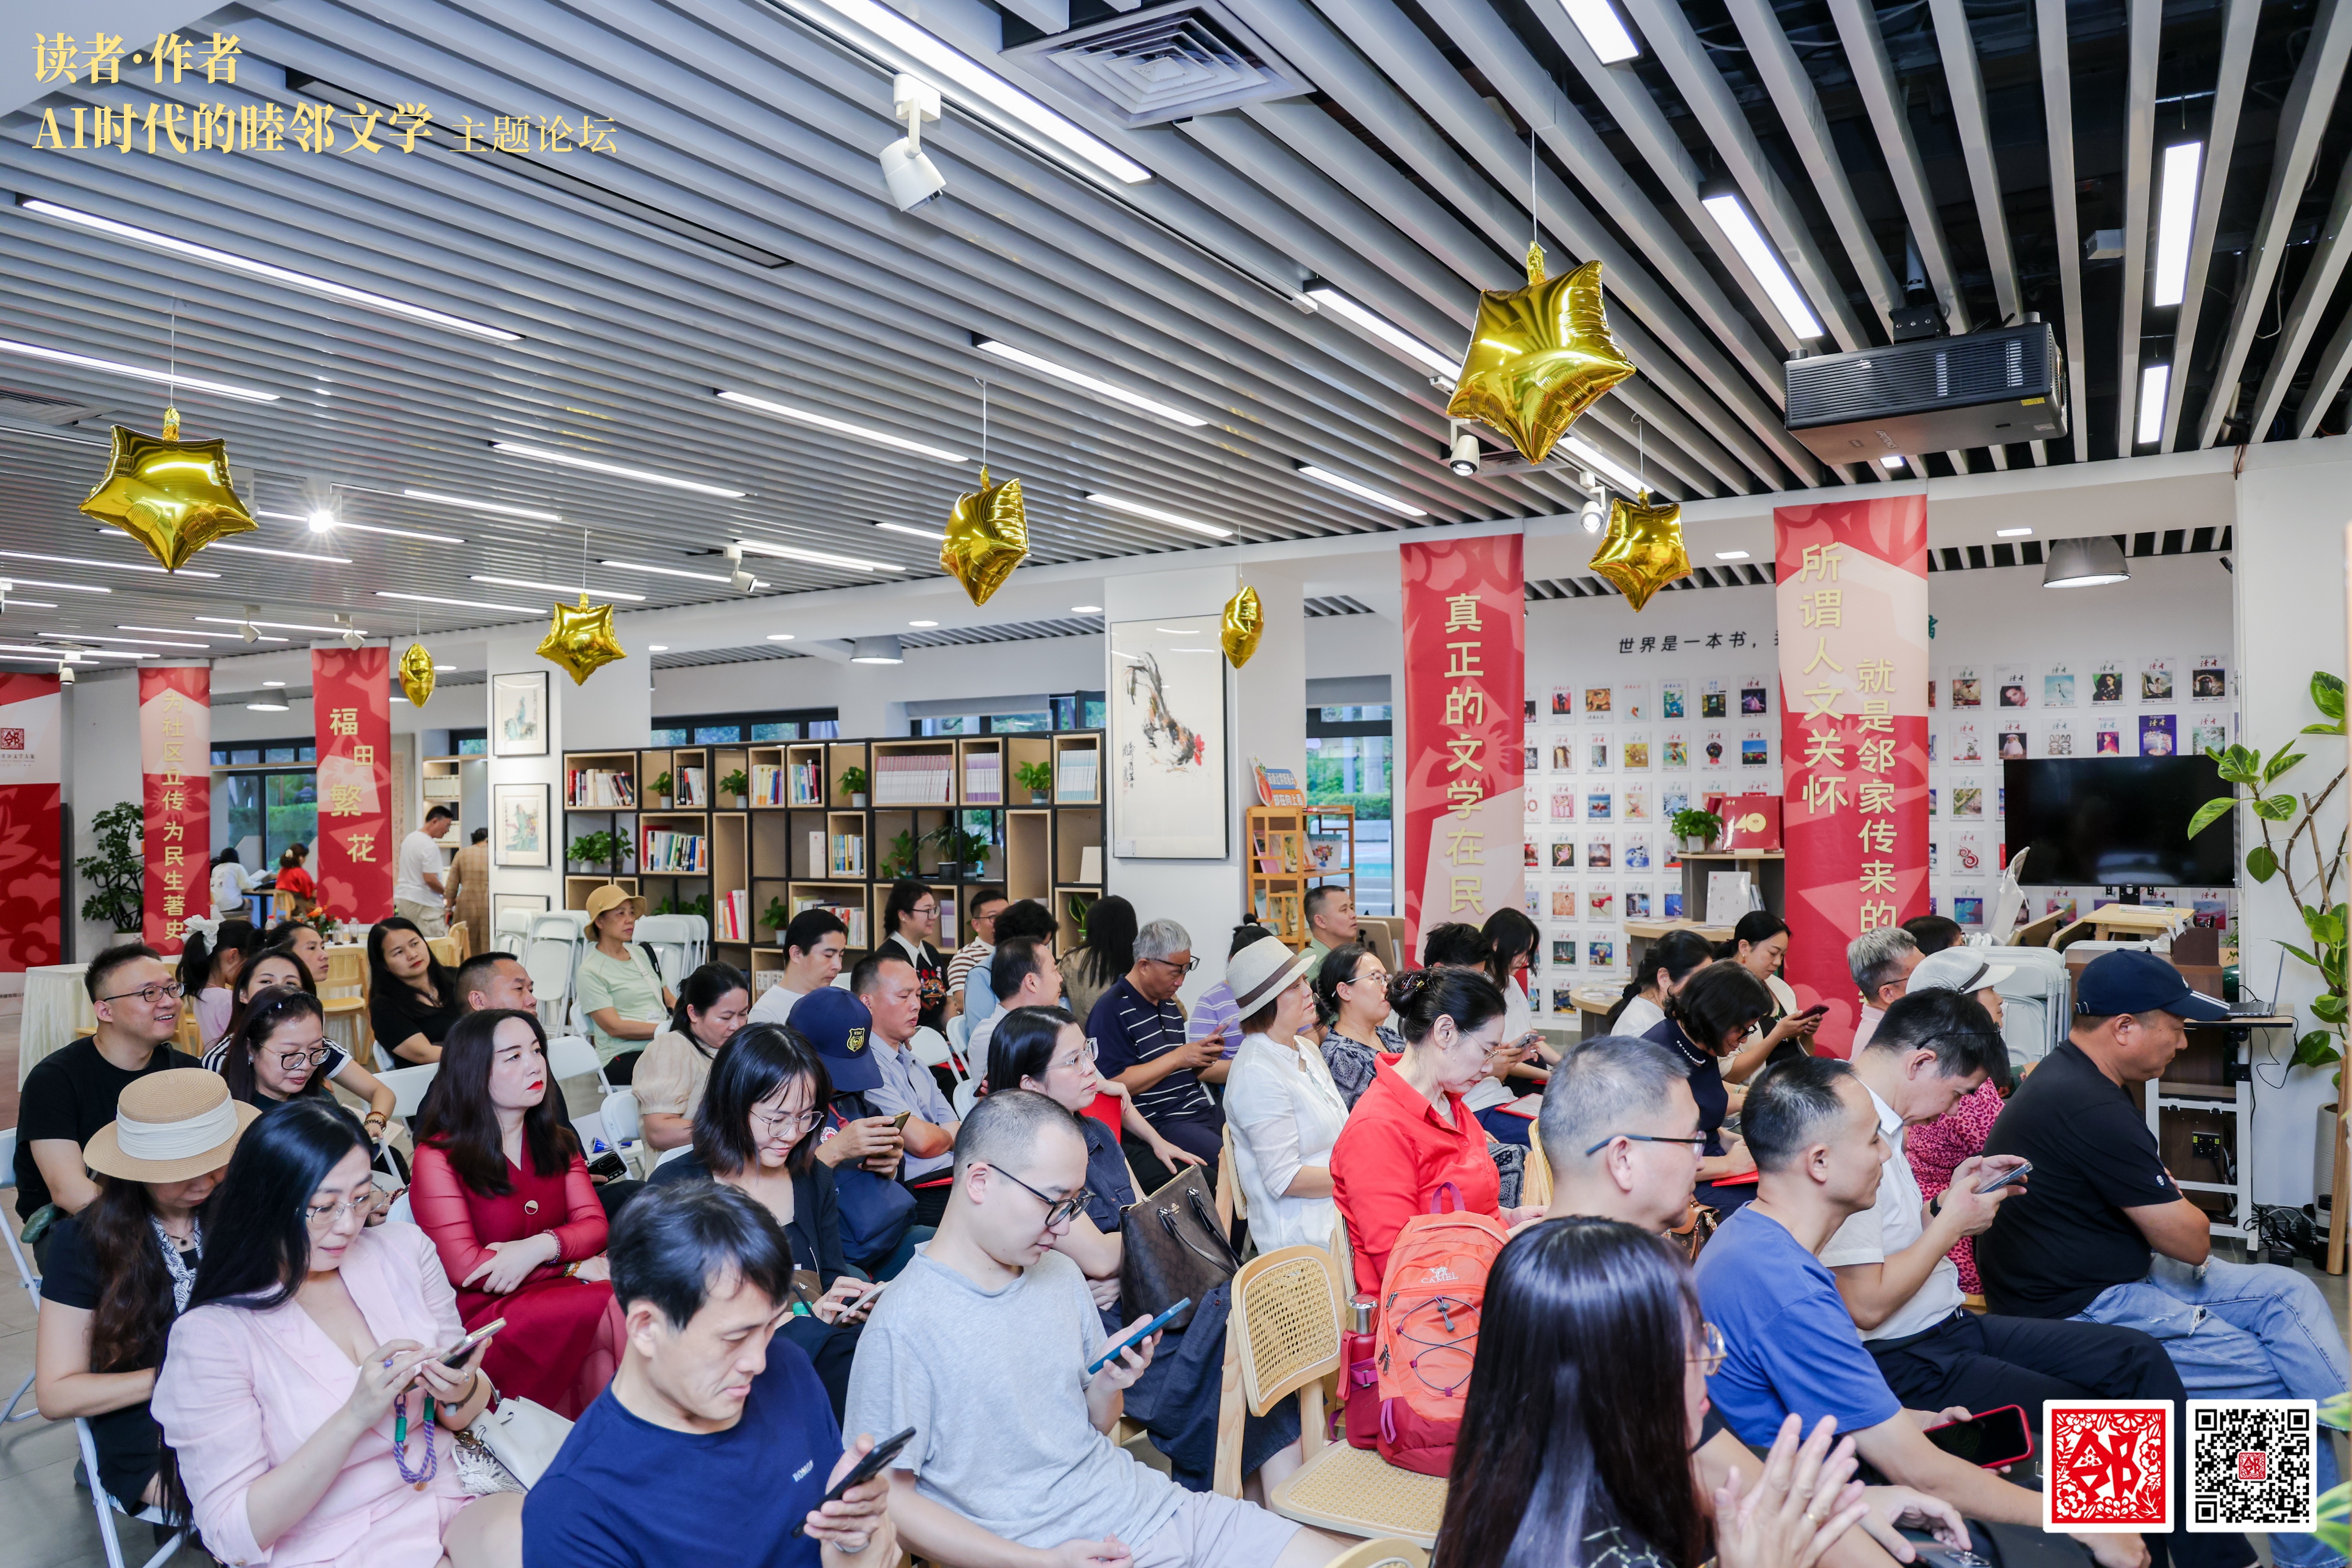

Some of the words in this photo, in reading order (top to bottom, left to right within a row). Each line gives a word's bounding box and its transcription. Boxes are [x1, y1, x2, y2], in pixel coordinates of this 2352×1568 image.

[1619, 631, 1779, 653] 世界是一本书，
[2200, 659, 2218, 667] 读者
[1799, 542, 1848, 815] 所谓人文关怀
[2005, 723, 2021, 731] 读者
[2149, 719, 2166, 727] 读者
[2200, 717, 2216, 725] 读者
[1444, 593, 1484, 932] 真正的文学在民
[329, 708, 376, 863] 福田繁花
[1273, 794, 1303, 806] 却在向上看
[1857, 659, 1897, 933] 就是邻家传来的
[1734, 813, 1767, 833] 40
[1421, 1272, 1459, 1283] CAMEL
